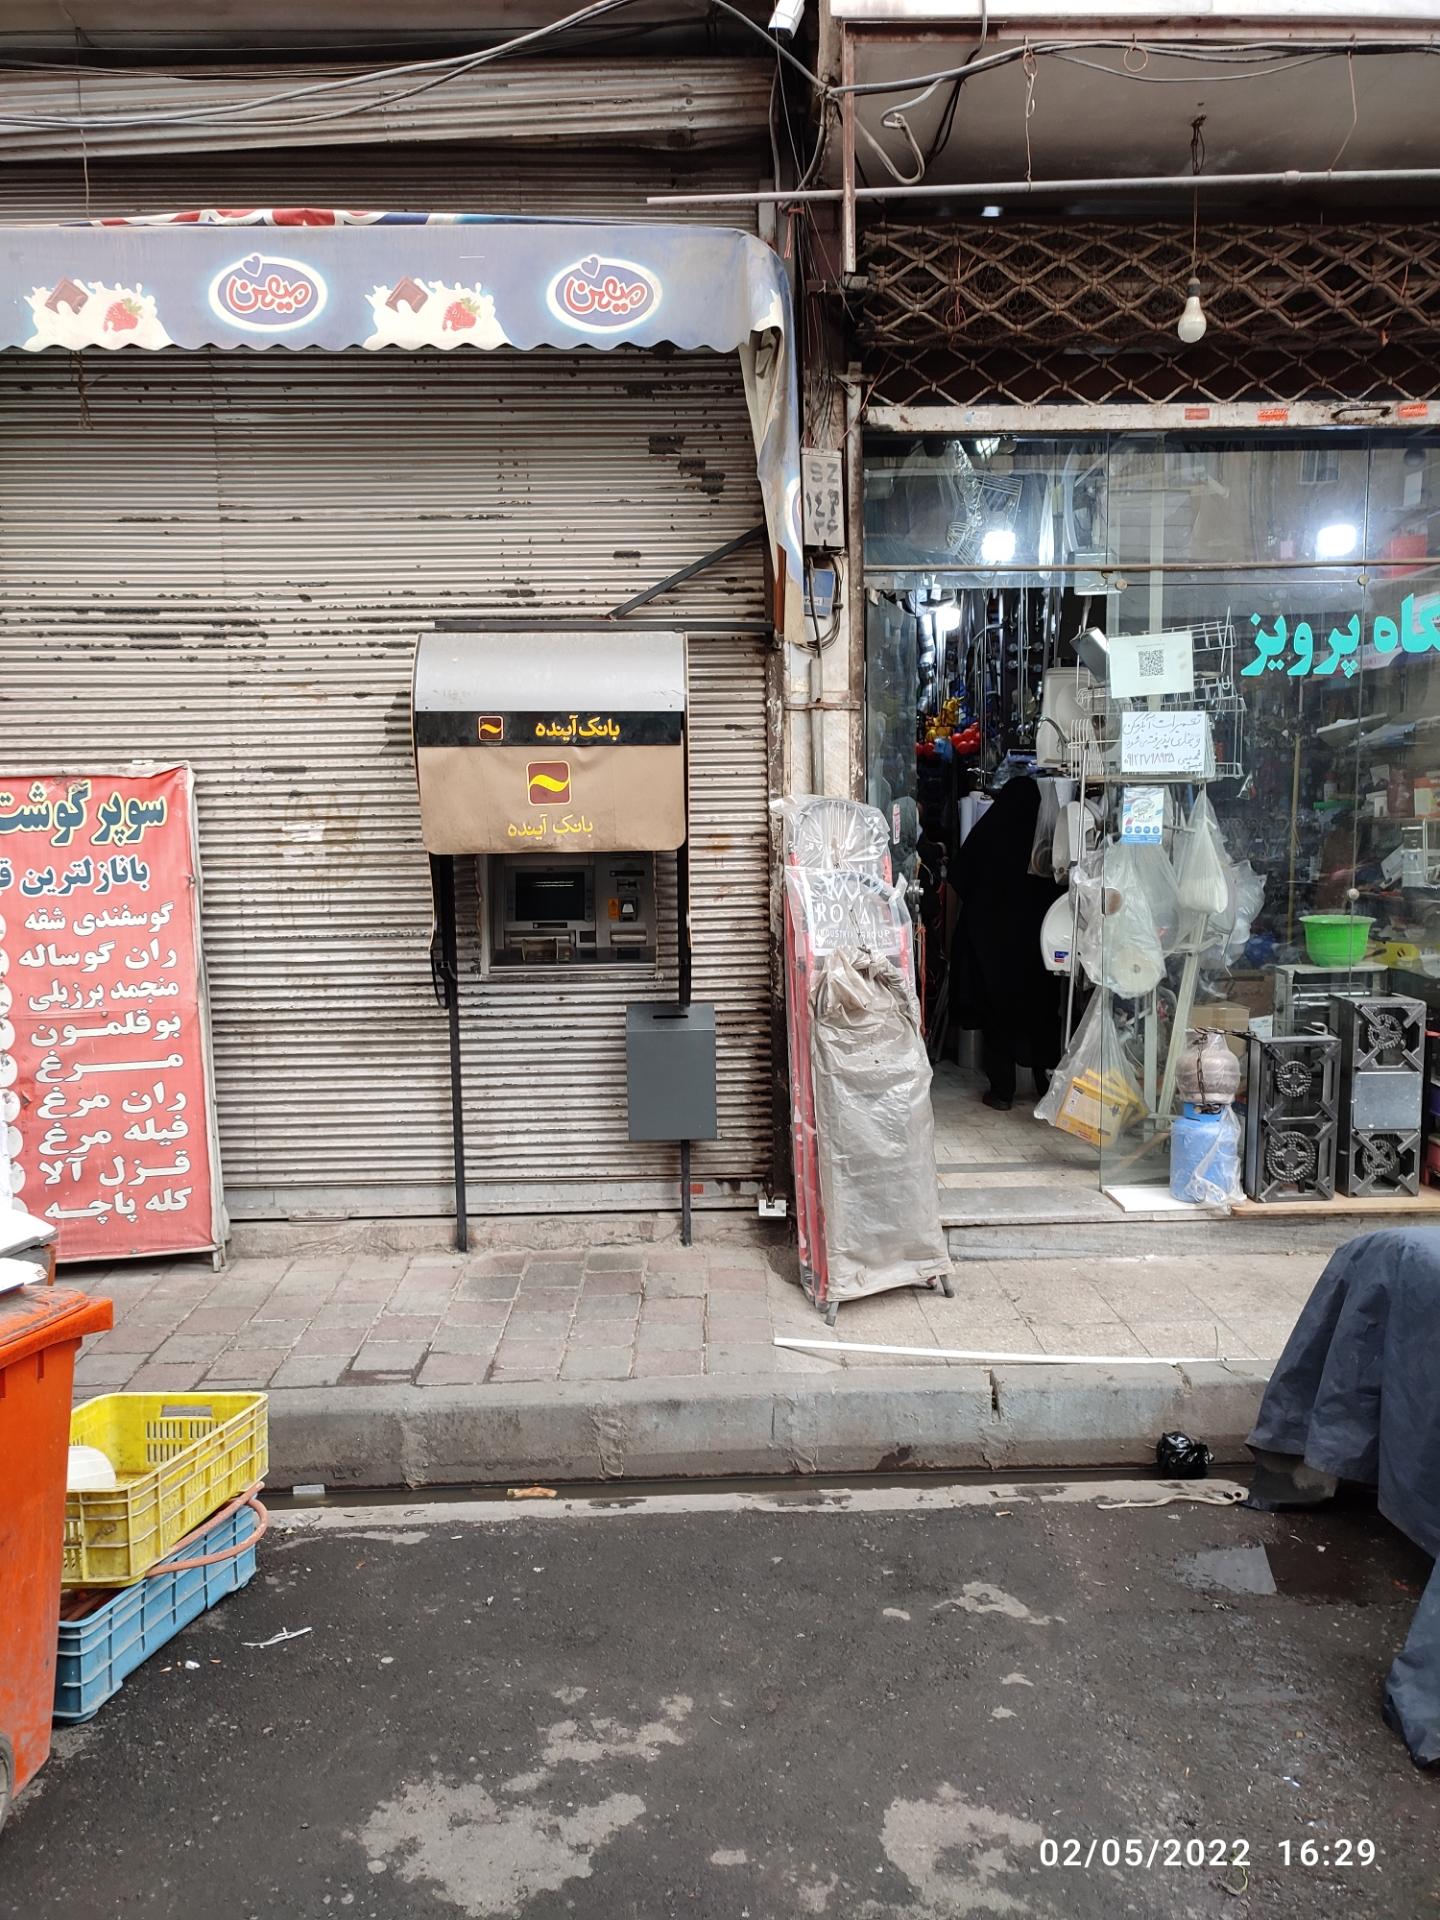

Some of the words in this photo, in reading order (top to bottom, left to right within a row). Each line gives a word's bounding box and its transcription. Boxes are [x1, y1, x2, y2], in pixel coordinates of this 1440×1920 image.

[225, 273, 313, 315] میهن
[563, 274, 649, 316] میهن
[1241, 611, 1360, 679] پرویز
[535, 715, 578, 743] آینده
[578, 717, 622, 740] بانک
[90, 792, 167, 846] سوپر
[507, 814, 548, 840] آینده
[552, 814, 594, 838] بانک
[24, 907, 66, 931] شقه
[72, 903, 175, 936] گوسفندی
[814, 902, 890, 925] ROAL
[18, 940, 116, 973] گوساله
[124, 938, 178, 969] ران
[28, 979, 105, 1011] برزیلی
[110, 977, 180, 1003] منجمد
[30, 1009, 182, 1047] بوقلمون
[35, 1050, 184, 1084] مرغ
[36, 1086, 111, 1119] مرغ
[121, 1081, 187, 1114] ران
[38, 1122, 113, 1155] مرغ
[123, 1114, 189, 1146] فیله
[39, 1155, 88, 1185] آلا
[99, 1149, 191, 1186] قزل
[44, 1191, 137, 1225] پاچه
[145, 1187, 193, 1212] کله
